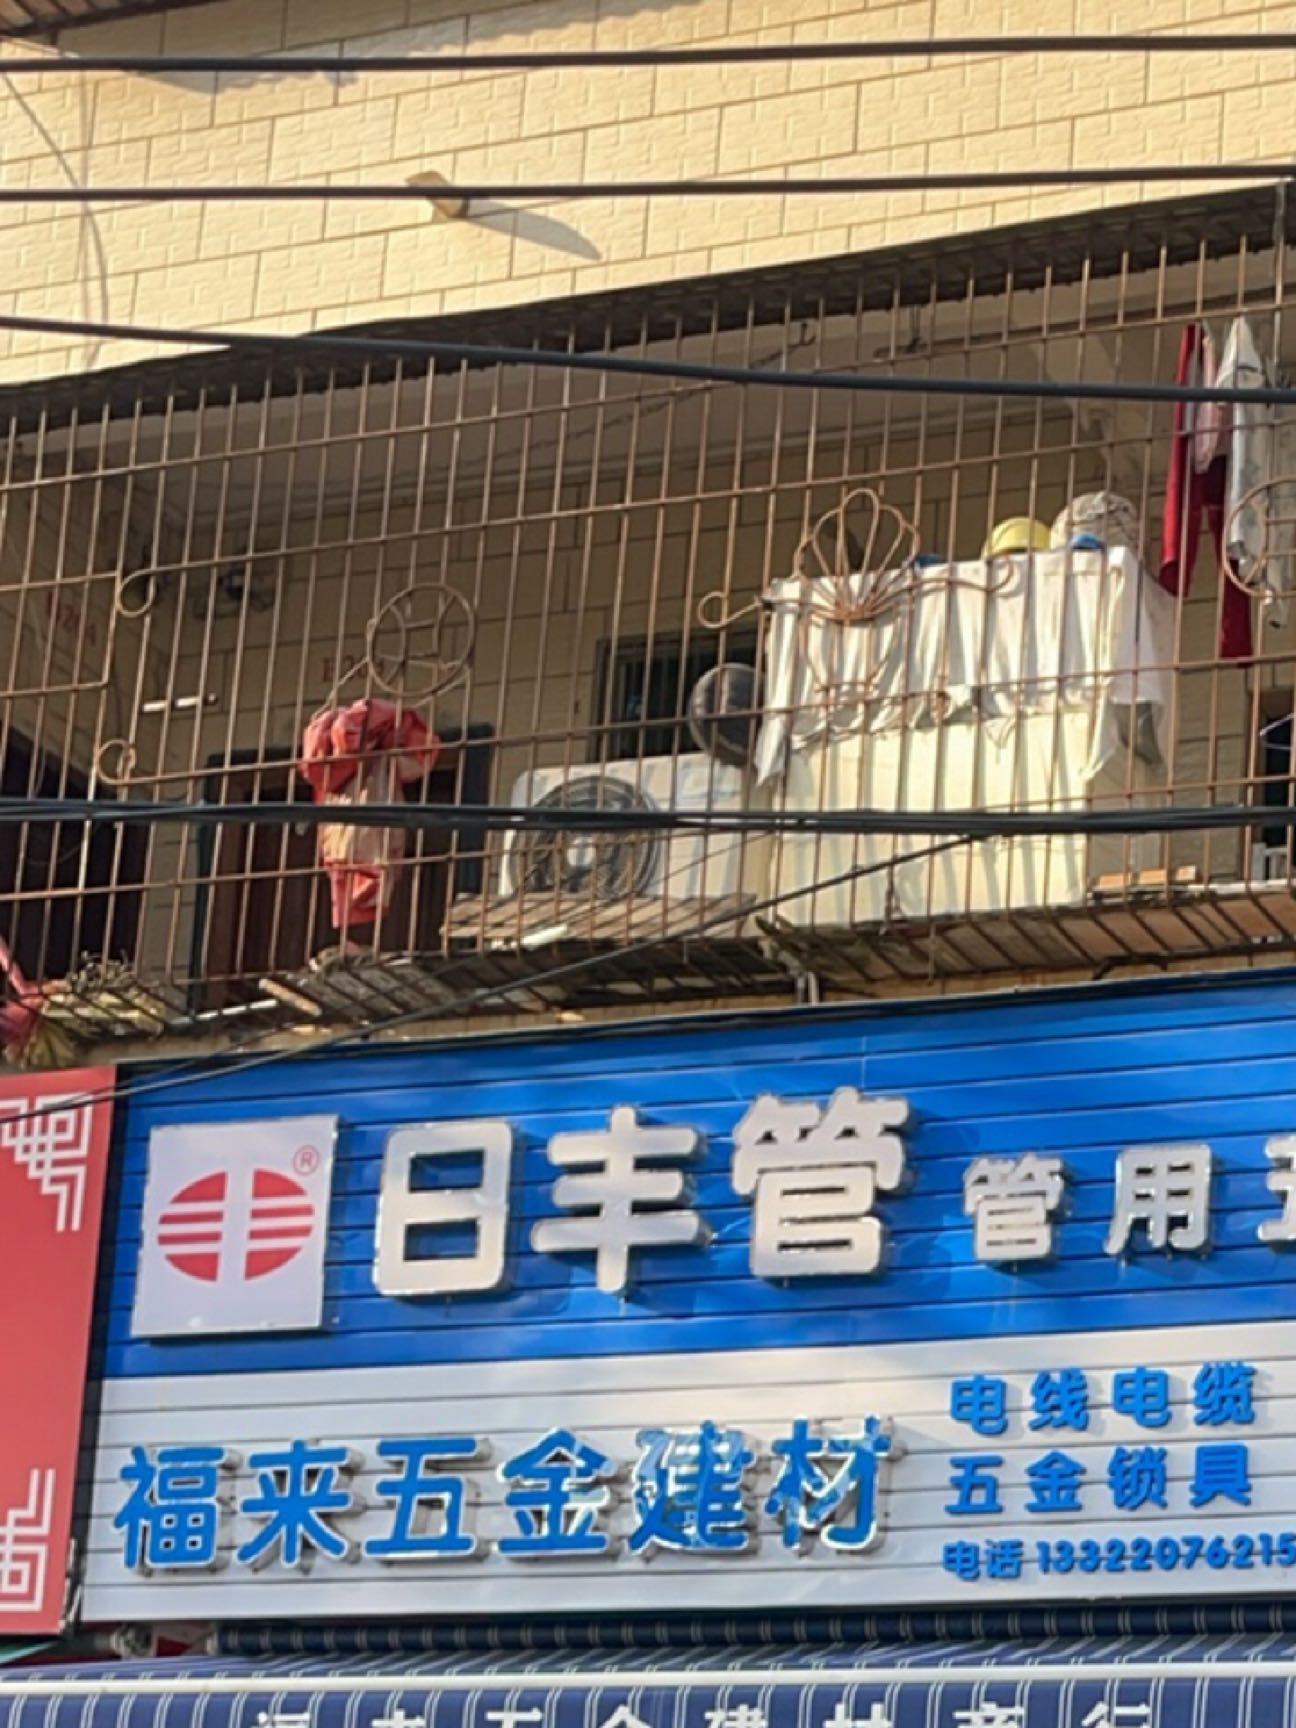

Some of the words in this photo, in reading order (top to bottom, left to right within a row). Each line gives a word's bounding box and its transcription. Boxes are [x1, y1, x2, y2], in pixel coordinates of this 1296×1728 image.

[372, 1088, 908, 1297] 日丰管
[950, 1361, 1258, 1436] 电线电缆
[114, 1414, 895, 1571] 福来五金建材
[945, 1442, 1252, 1513] 五金锁具
[943, 1540, 1023, 1581] 电话
